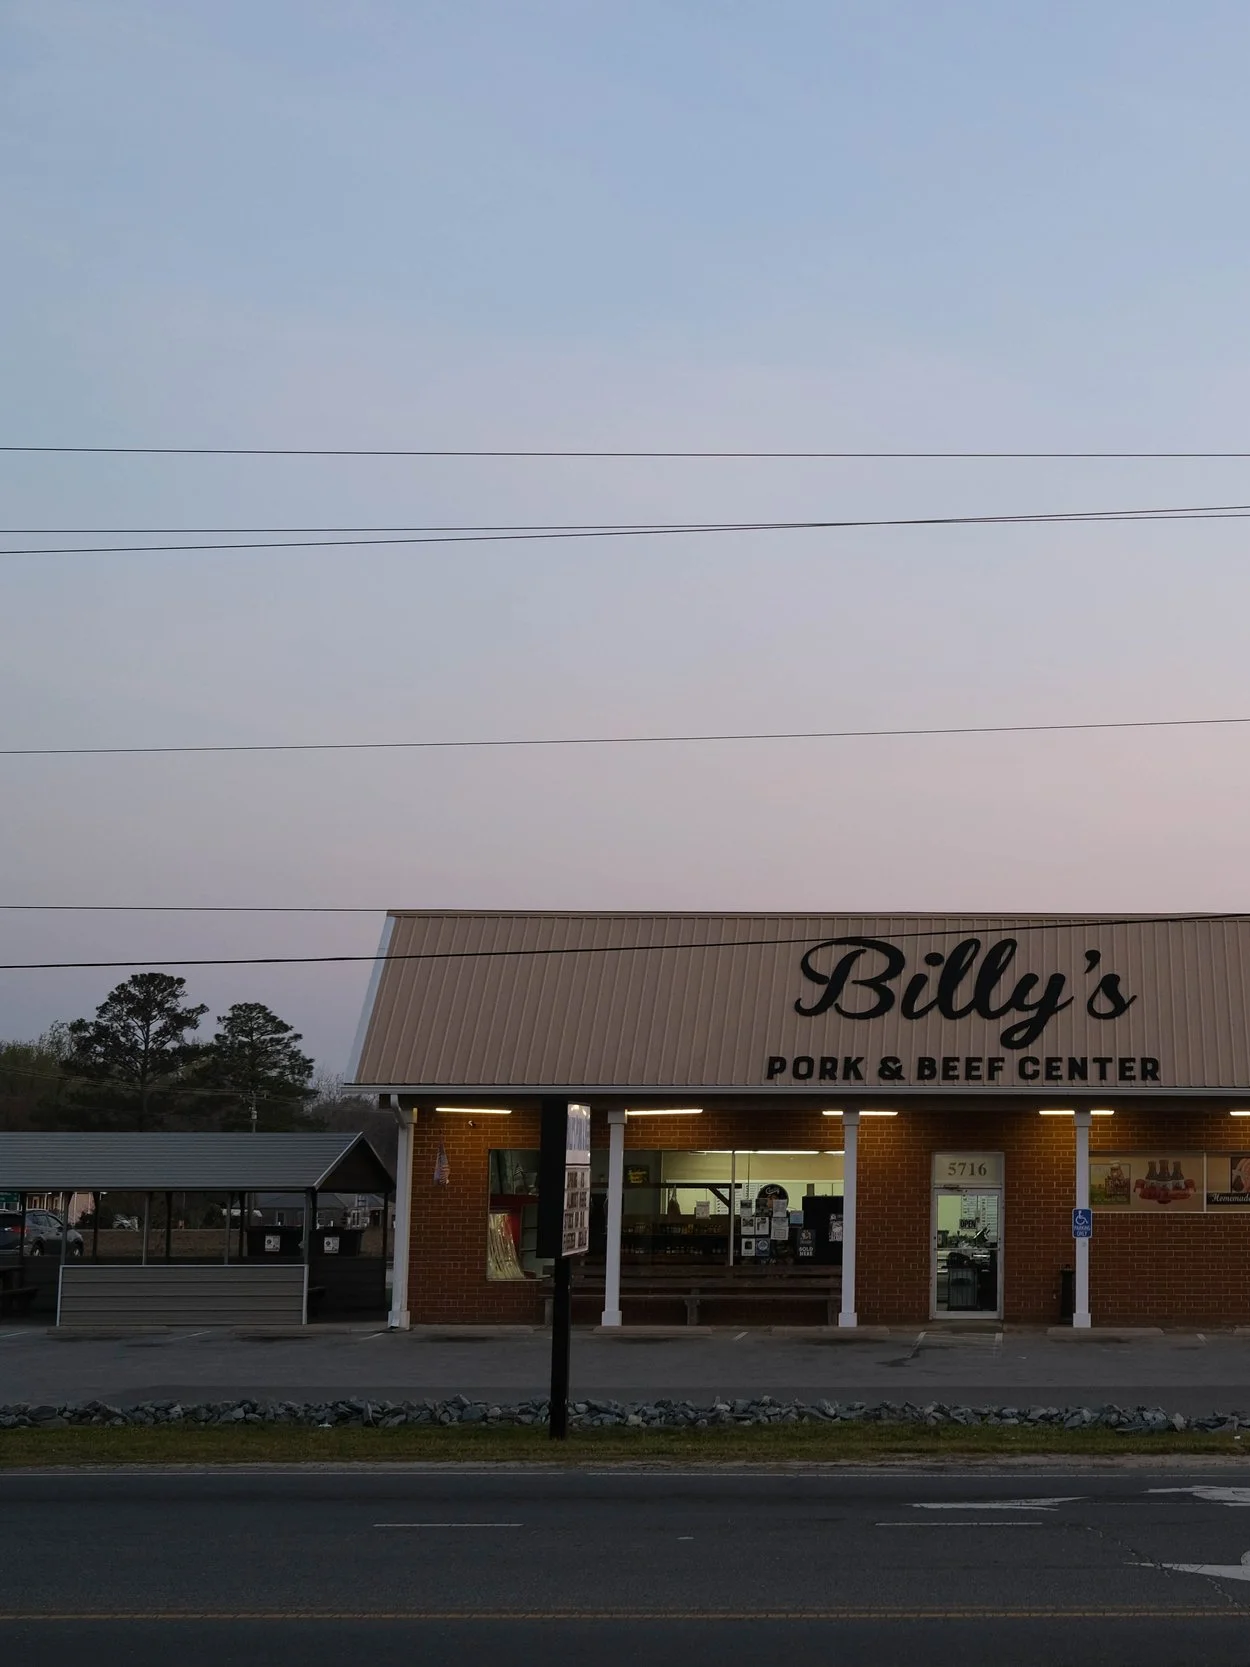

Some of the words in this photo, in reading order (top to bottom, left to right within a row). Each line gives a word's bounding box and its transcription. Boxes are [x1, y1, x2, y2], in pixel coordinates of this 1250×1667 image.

[794, 936, 1138, 1050] Billy's
[766, 1056, 865, 1081] PORK
[878, 1056, 905, 1081] &
[917, 1056, 1006, 1081] BEEF
[1018, 1056, 1161, 1081] CENTER
[948, 1162, 987, 1176] 5716
[960, 1219, 977, 1228] OPEN
